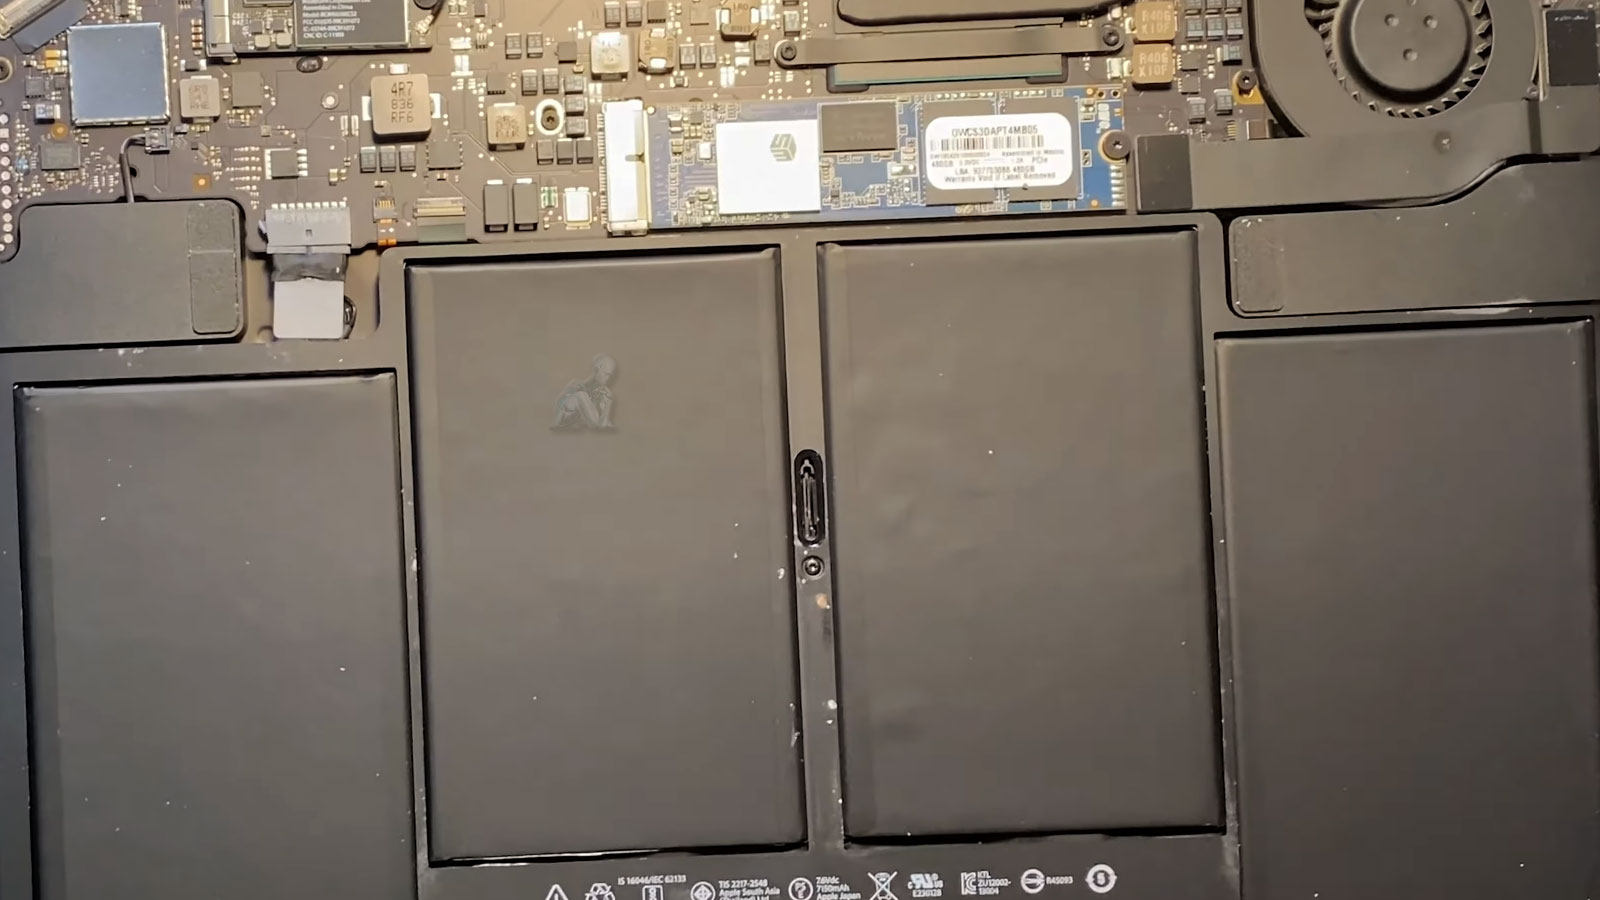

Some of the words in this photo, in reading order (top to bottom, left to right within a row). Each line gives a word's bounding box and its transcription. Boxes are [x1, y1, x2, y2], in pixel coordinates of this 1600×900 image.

[391, 81, 414, 96] 4R7
[391, 98, 414, 110] 836
[391, 111, 414, 123] RF6
[718, 879, 731, 889] TIS
